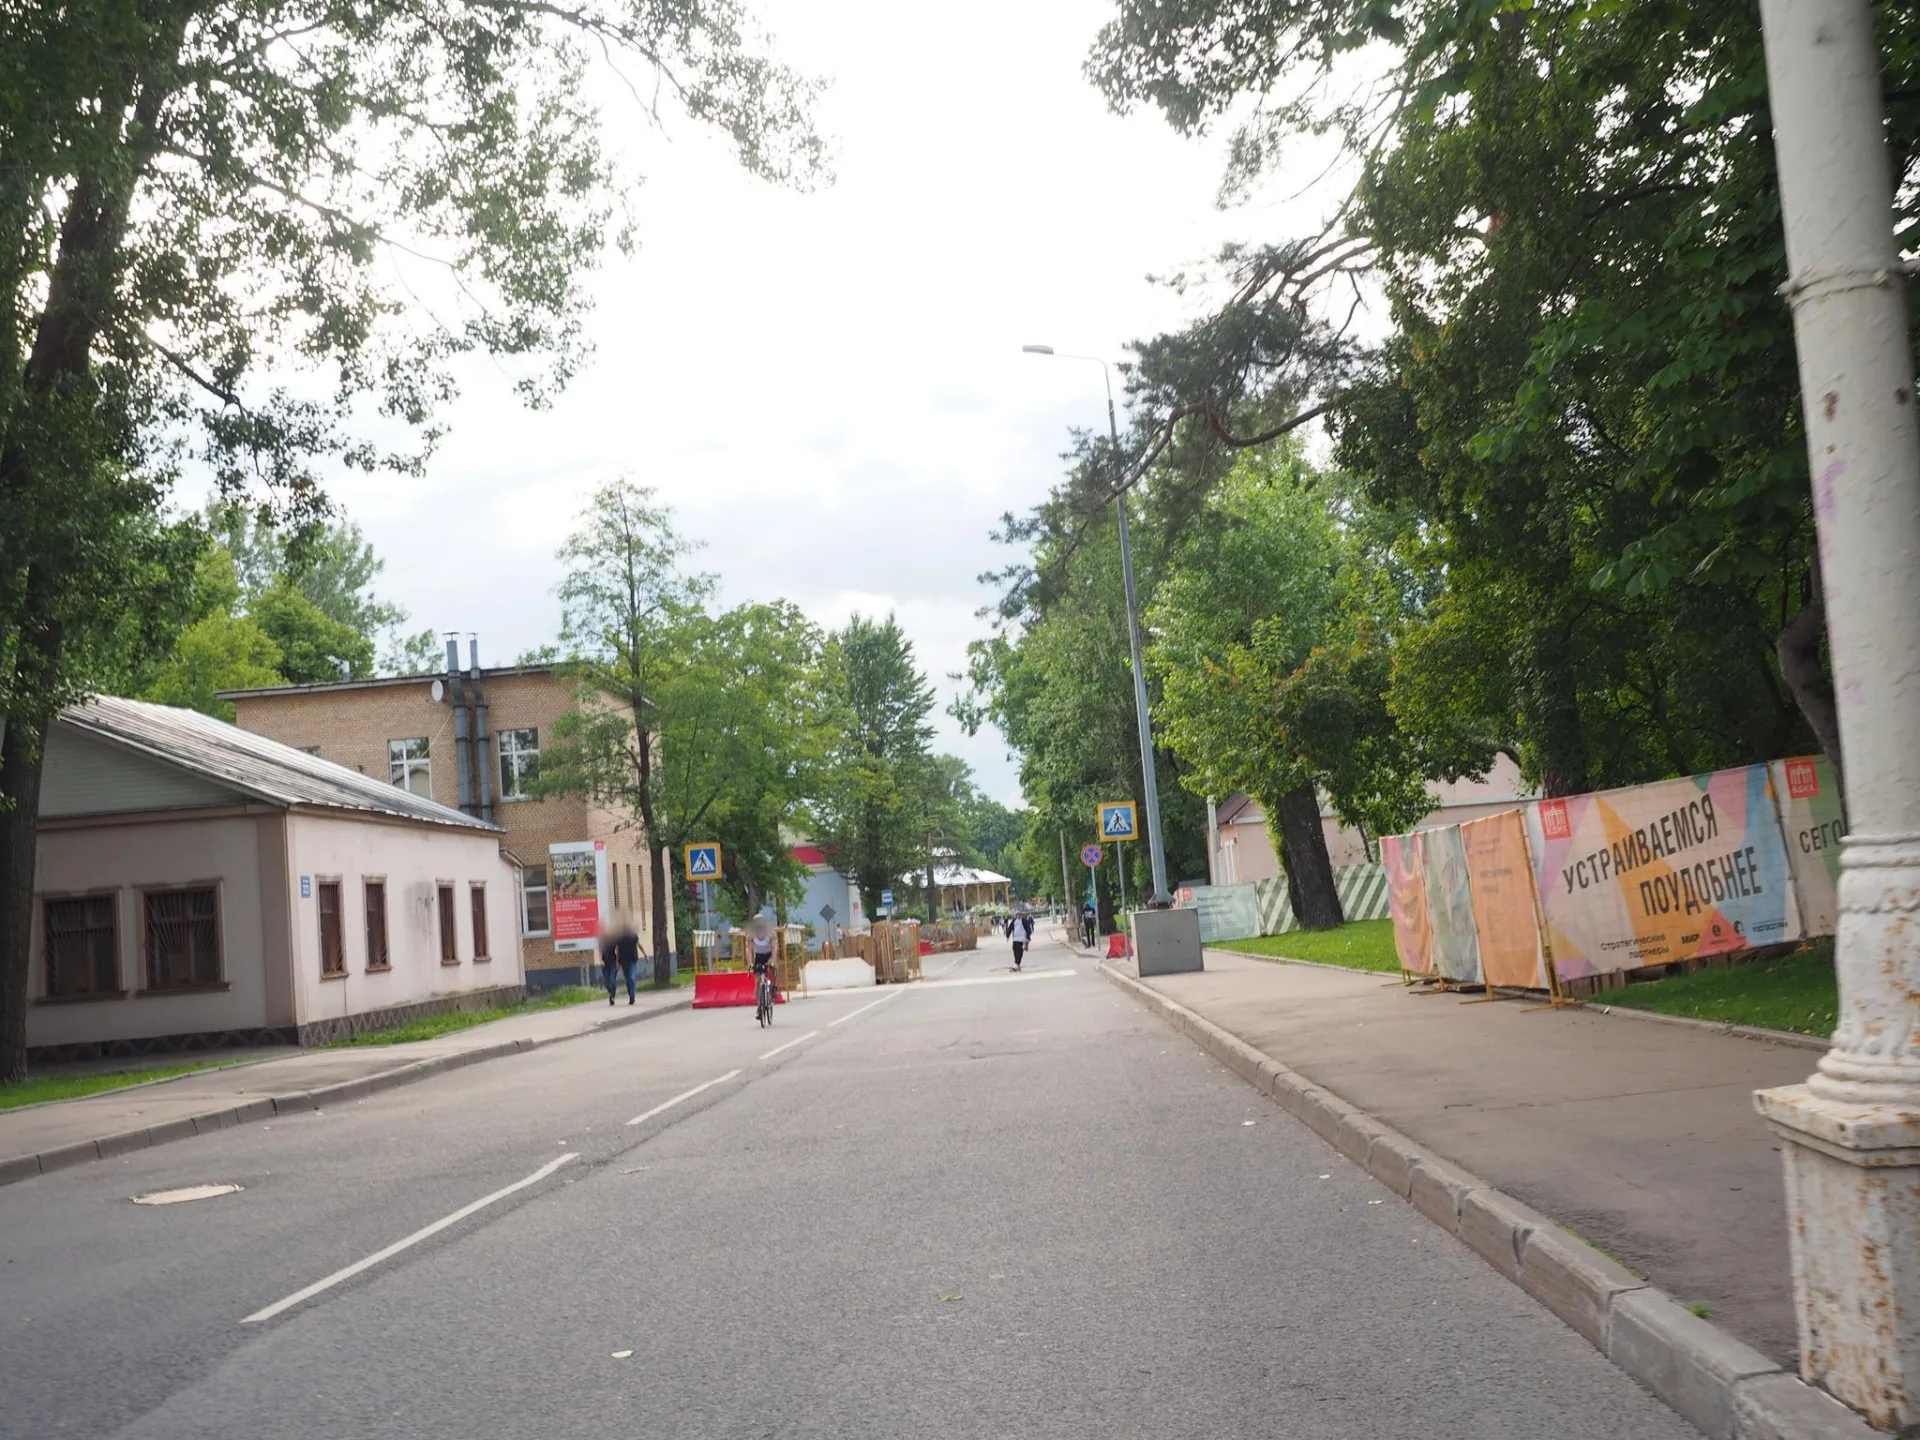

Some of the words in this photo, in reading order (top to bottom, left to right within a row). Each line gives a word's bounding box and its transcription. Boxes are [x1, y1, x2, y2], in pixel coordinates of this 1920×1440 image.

[553, 860, 594, 869] ГОРОДСКАЯ
[1562, 794, 1718, 893] УСТРАИВАЕМСЯ
[1640, 846, 1762, 916] ПОУДОБНЕЕ
[1600, 933, 1666, 951] Стратегические
